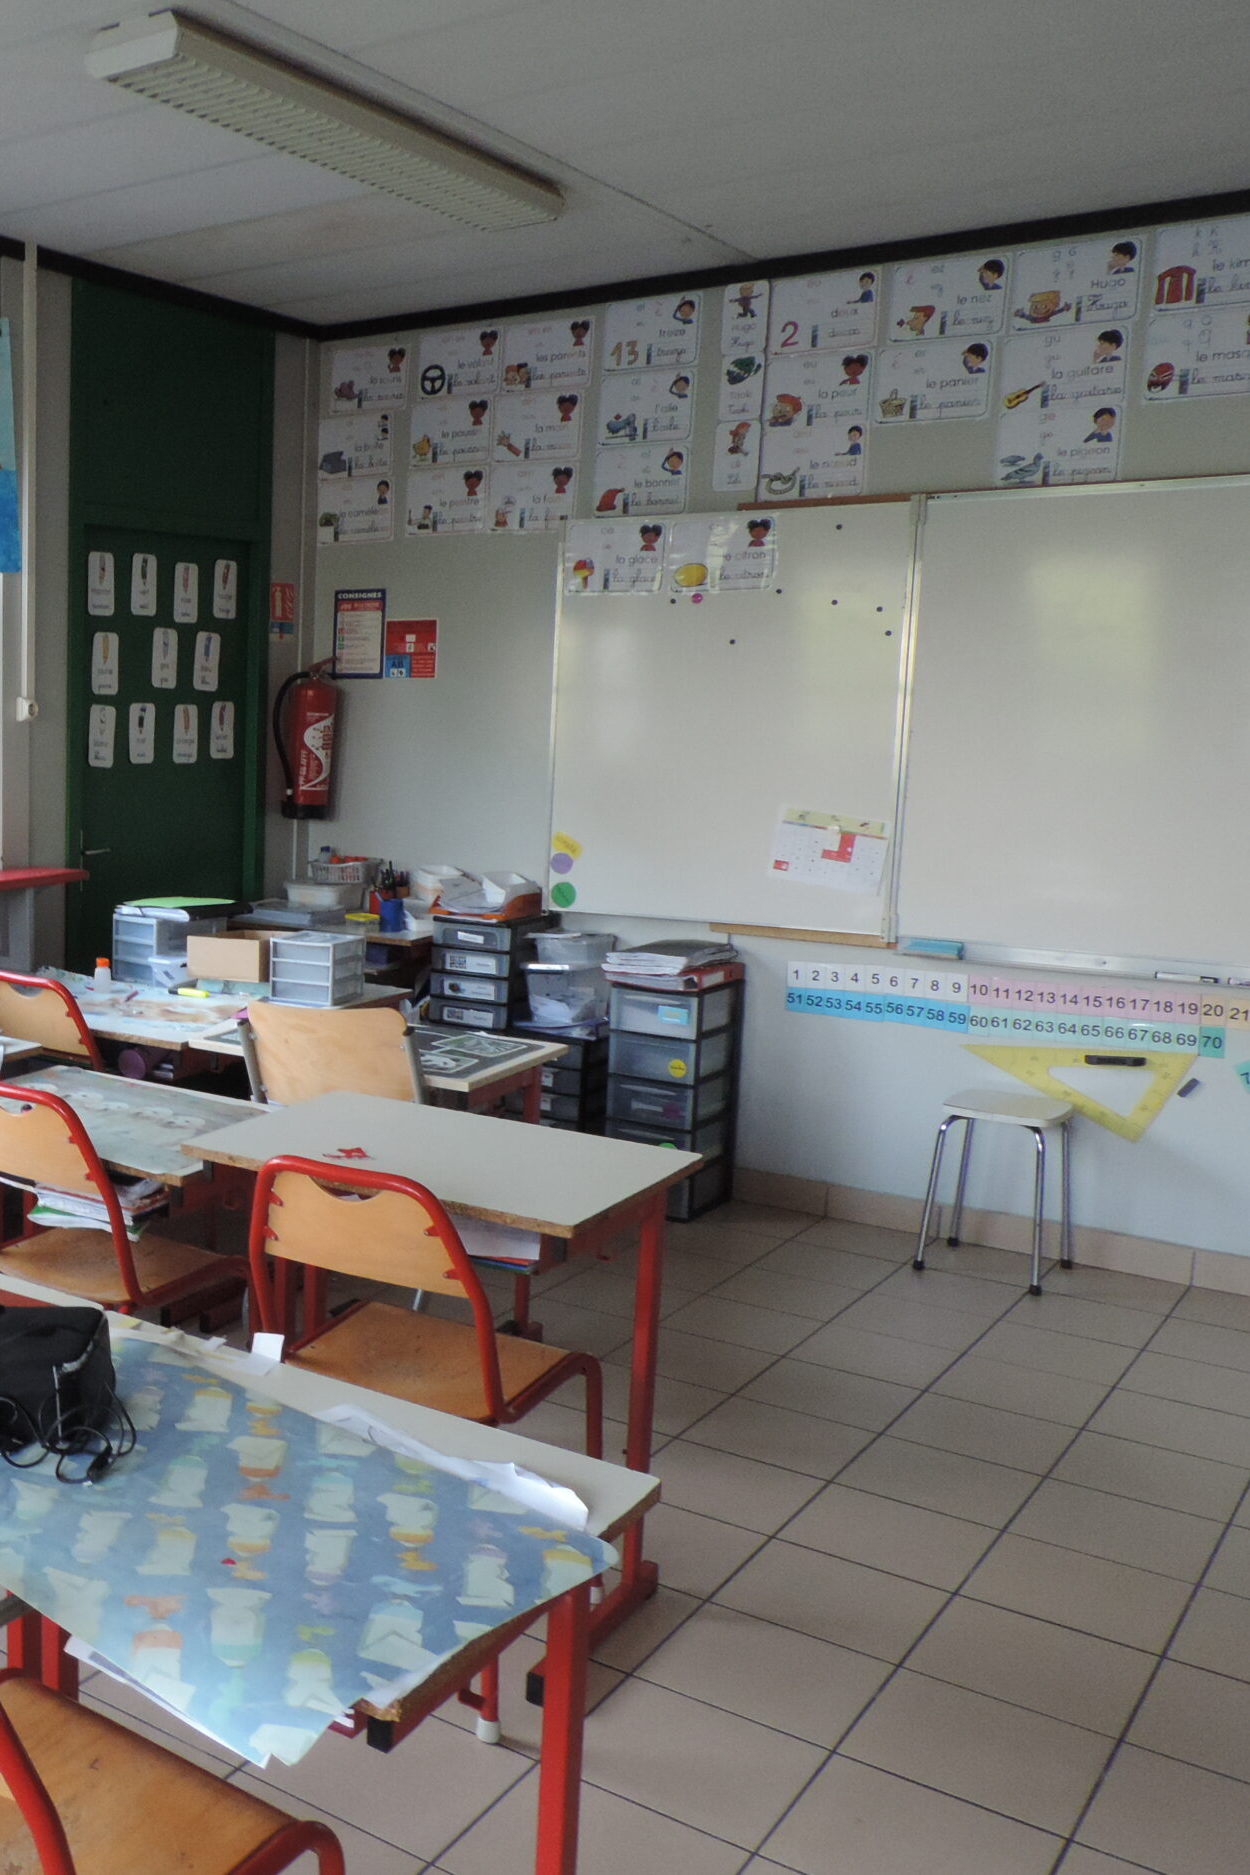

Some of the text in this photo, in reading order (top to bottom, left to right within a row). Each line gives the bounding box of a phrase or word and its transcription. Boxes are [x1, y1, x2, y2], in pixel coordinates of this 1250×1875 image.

[957, 295, 967, 305] le
[781, 320, 799, 348] 2
[611, 340, 639, 366] 13
[1196, 350, 1208, 362] le
[1051, 365, 1114, 382] la guitare
[926, 377, 978, 390] le panier
[818, 388, 828, 399] la
[1057, 446, 1111, 458] le pigeon
[634, 479, 642, 488] le
[616, 554, 626, 564] la
[338, 591, 382, 600] CONSIGNES
[793, 969, 1250, 1022] 1 2 3 4 5 6 7 8 9 10 11 12 13 14 15 16 17 18 19 20 21
[786, 992, 1222, 1049] 51 52 53 54 55 56 57 58 59 60 61 62 63 64 65 66 67 68 69 70
